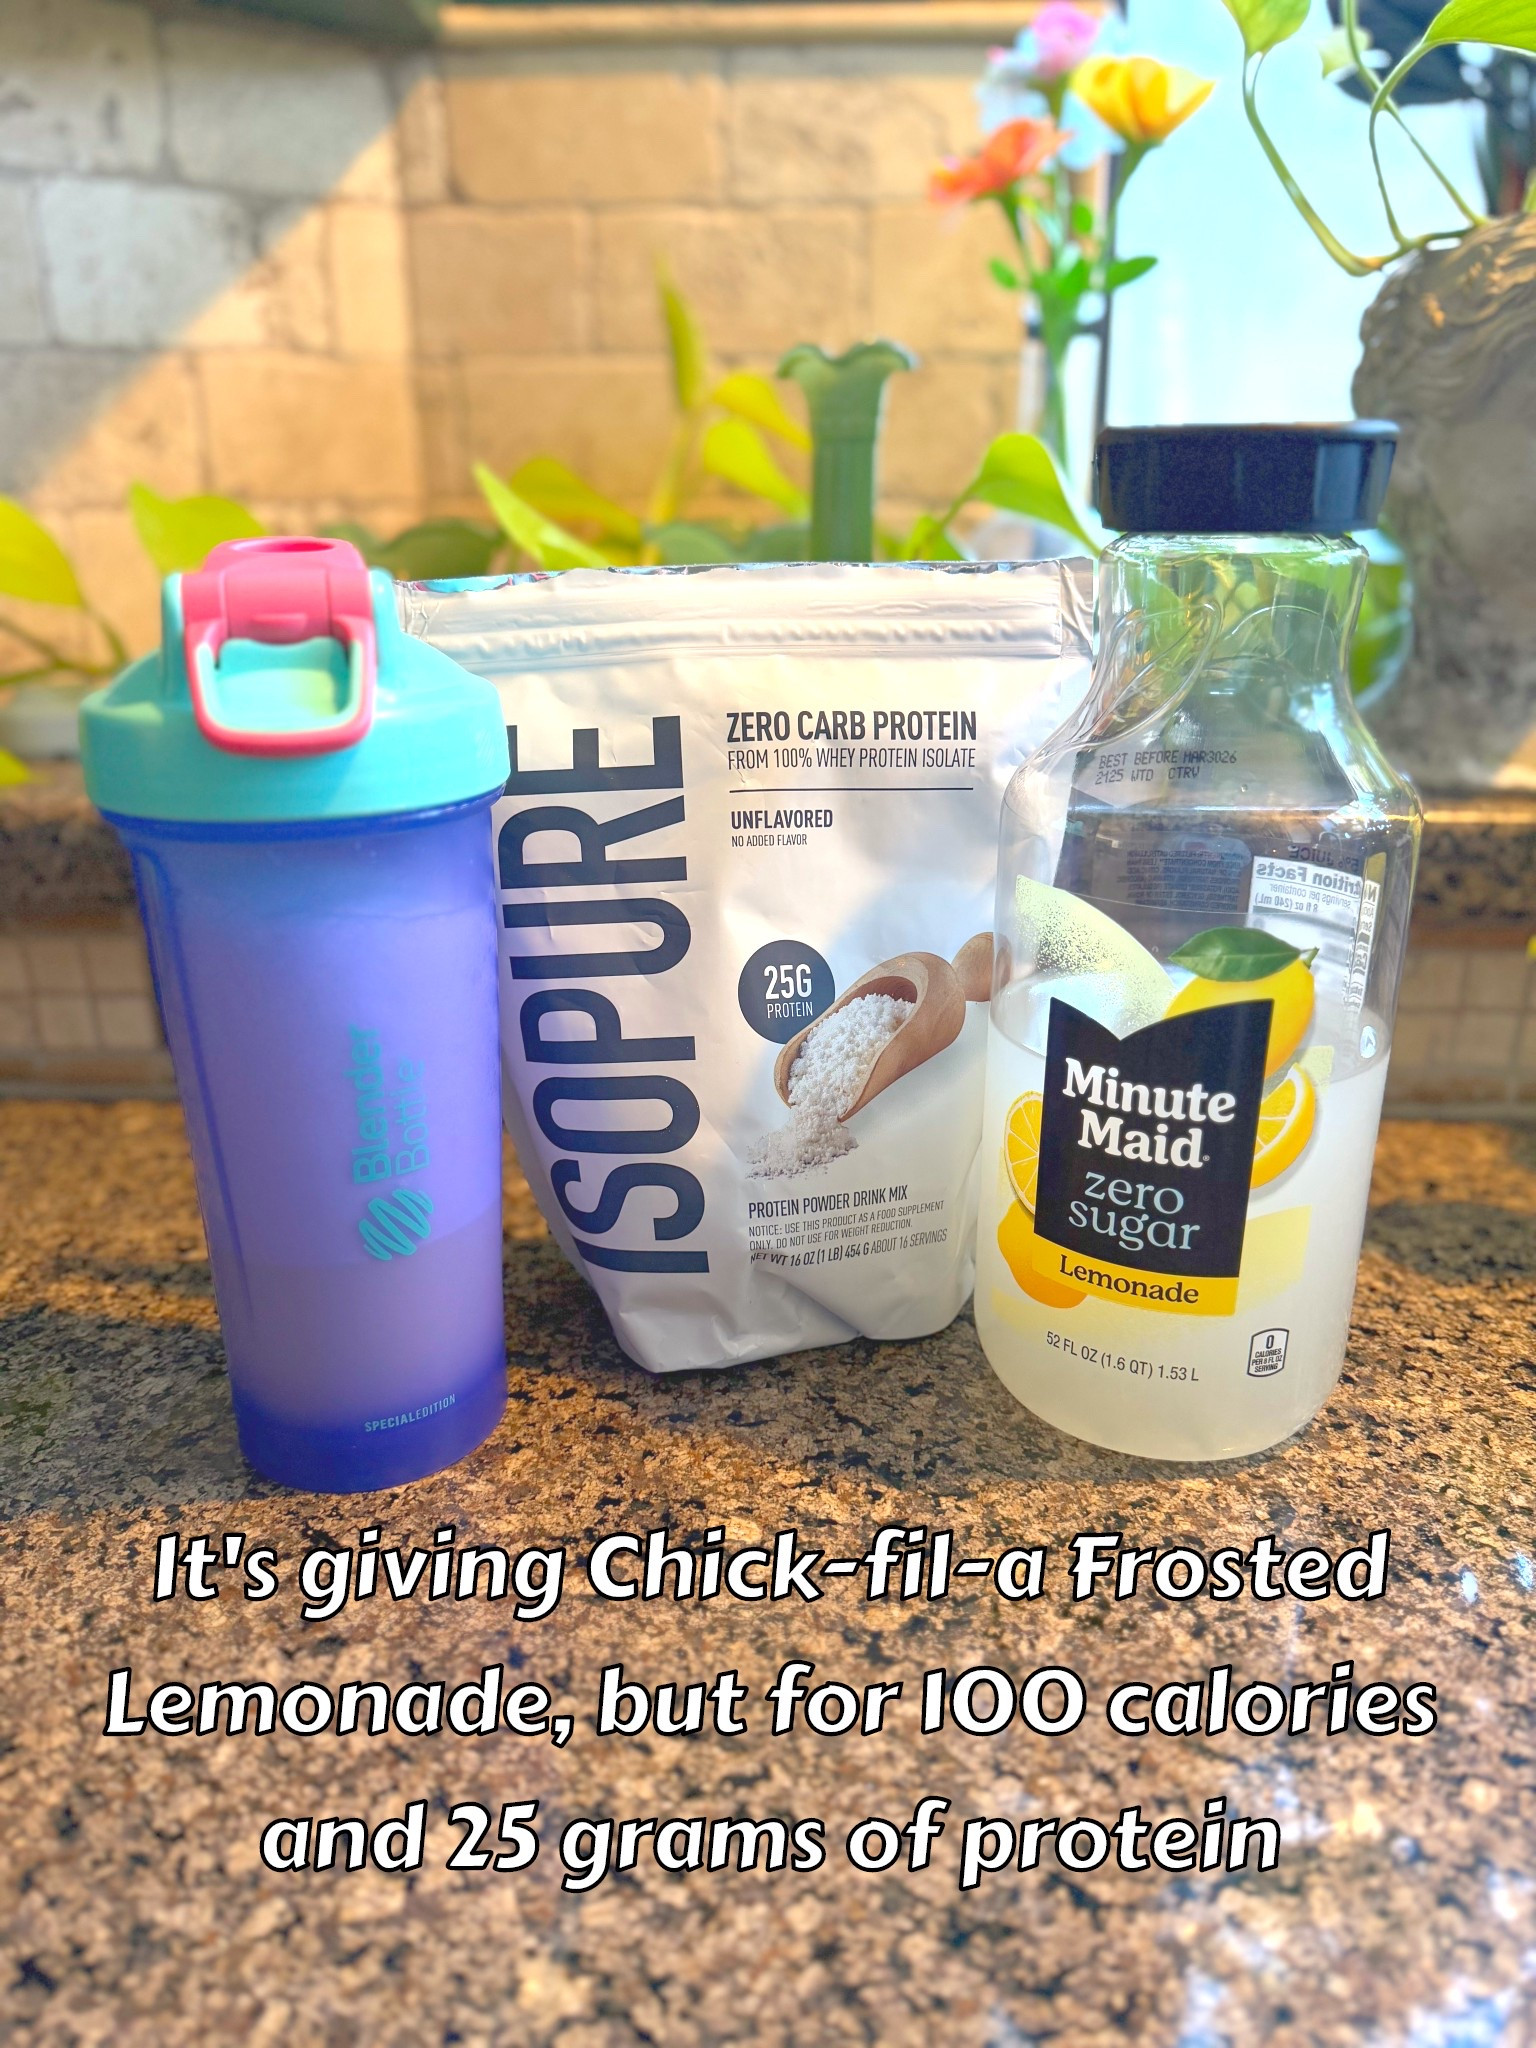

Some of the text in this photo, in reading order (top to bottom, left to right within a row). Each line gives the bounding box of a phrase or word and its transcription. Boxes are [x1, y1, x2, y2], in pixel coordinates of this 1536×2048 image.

[726, 710, 977, 742] ZERO CARB PROTEIN
[728, 748, 976, 770] FROM 100% WHEY PROTEIN ISOLATE
[1099, 752, 1128, 769] BEST
[1133, 751, 1179, 766] BEFORE
[731, 809, 833, 829] UNFLAVORED
[731, 834, 807, 848] NO ADDED FLAVOR
[498, 715, 710, 1273] ISOPURE
[763, 963, 812, 1000] 25G
[767, 1001, 813, 1019] PROTEIN
[343, 1022, 392, 1185] Blender
[1062, 1057, 1236, 1123] Minute
[390, 1056, 431, 1175] Bottle
[748, 1184, 908, 1219] PROTEIN POWDER DRINK MIX
[1084, 1171, 1184, 1215] zero
[748, 1200, 944, 1237] NOTICE: USE THIS PRODUCT AS A FOOD SUPPLEMENT
[749, 1218, 913, 1251] ONLY. DO NOT USE FOR WEIGHT REDUCTION.
[1068, 1200, 1200, 1251] sugar
[750, 1228, 948, 1267] NET WT 16 OZ (1 LB) 454 G ABOUT 16 SERVINGS
[1060, 1254, 1199, 1304] Lemonade
[1046, 1330, 1200, 1381] 52 FL OZ (1.6 QT) 1.53 L
[1254, 1347, 1282, 1359] CALORIES
[1265, 1334, 1275, 1350] 0
[1251, 1358, 1263, 1367] PER
[1267, 1356, 1275, 1364] FL
[1254, 1363, 1279, 1373] SERVING
